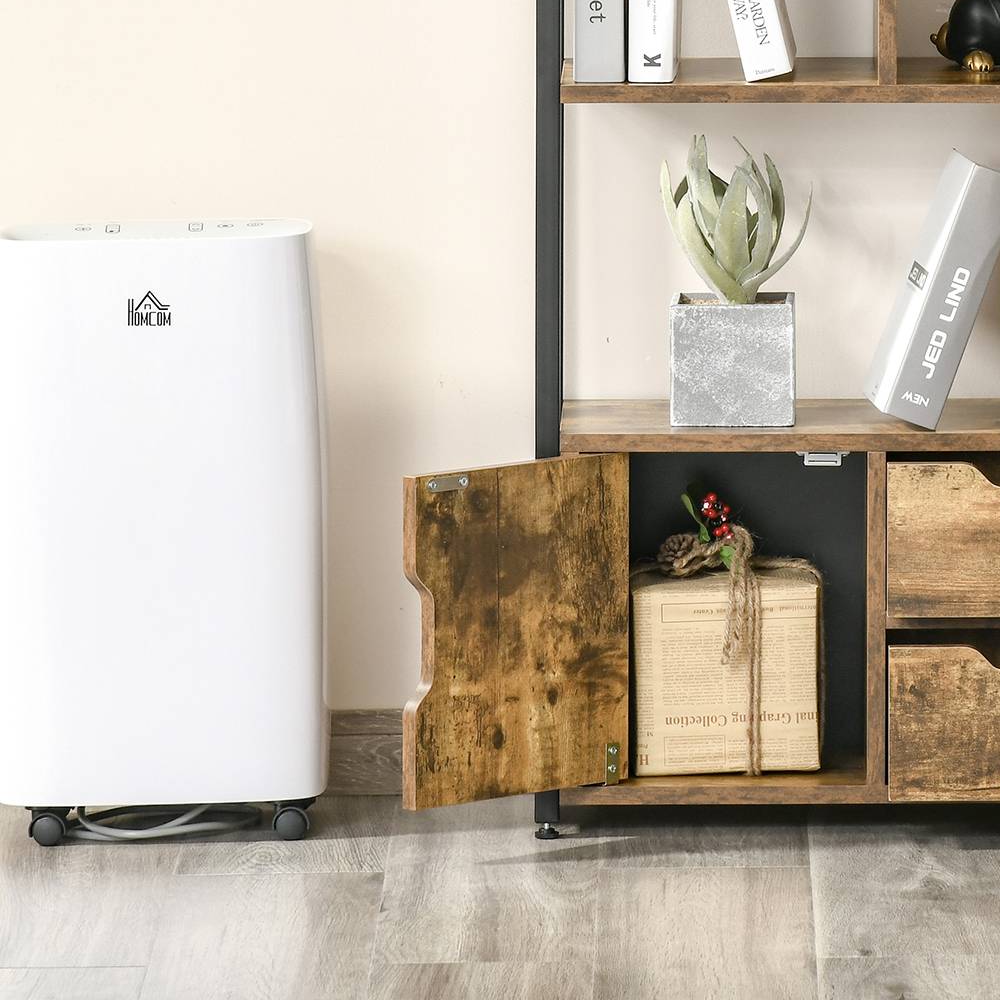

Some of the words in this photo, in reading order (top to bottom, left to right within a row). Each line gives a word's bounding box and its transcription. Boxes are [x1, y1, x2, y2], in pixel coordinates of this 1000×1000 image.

[127, 298, 171, 326] HOMCOM
[922, 330, 947, 379] JED
[939, 267, 971, 322] LIND
[901, 391, 929, 407] NEW
[665, 711, 727, 727] Collection
